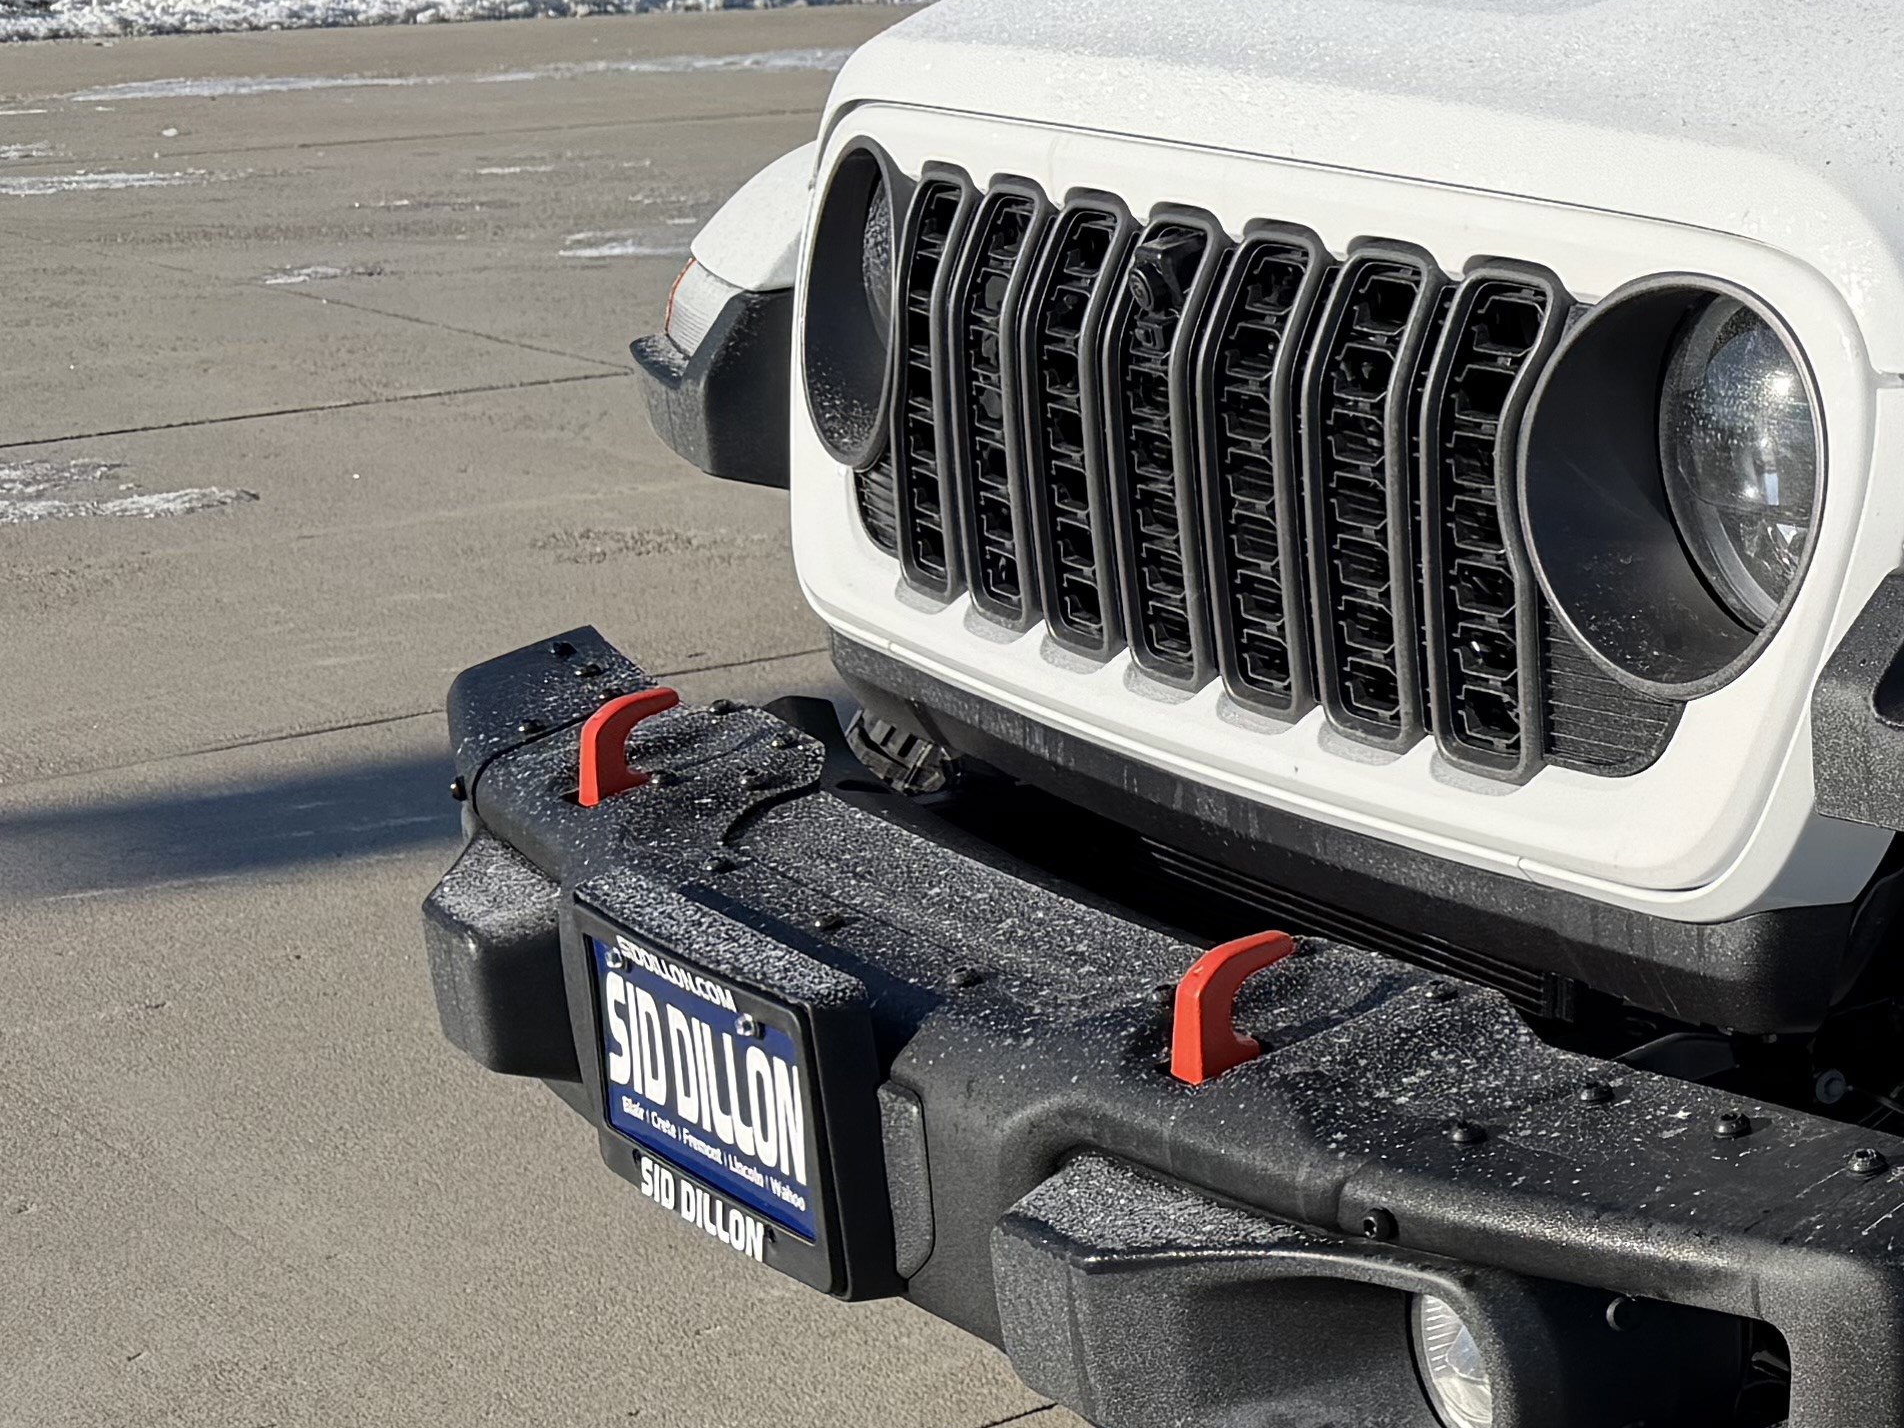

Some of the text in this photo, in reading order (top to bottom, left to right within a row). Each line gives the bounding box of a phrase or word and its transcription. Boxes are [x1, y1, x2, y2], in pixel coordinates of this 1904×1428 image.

[605, 971, 807, 1187] SID DILLON
[640, 1155, 766, 1263] SID DILLON
[651, 1110, 677, 1139] Crete
[682, 1126, 724, 1165] Fremont
[769, 1177, 807, 1213] Wahoo
